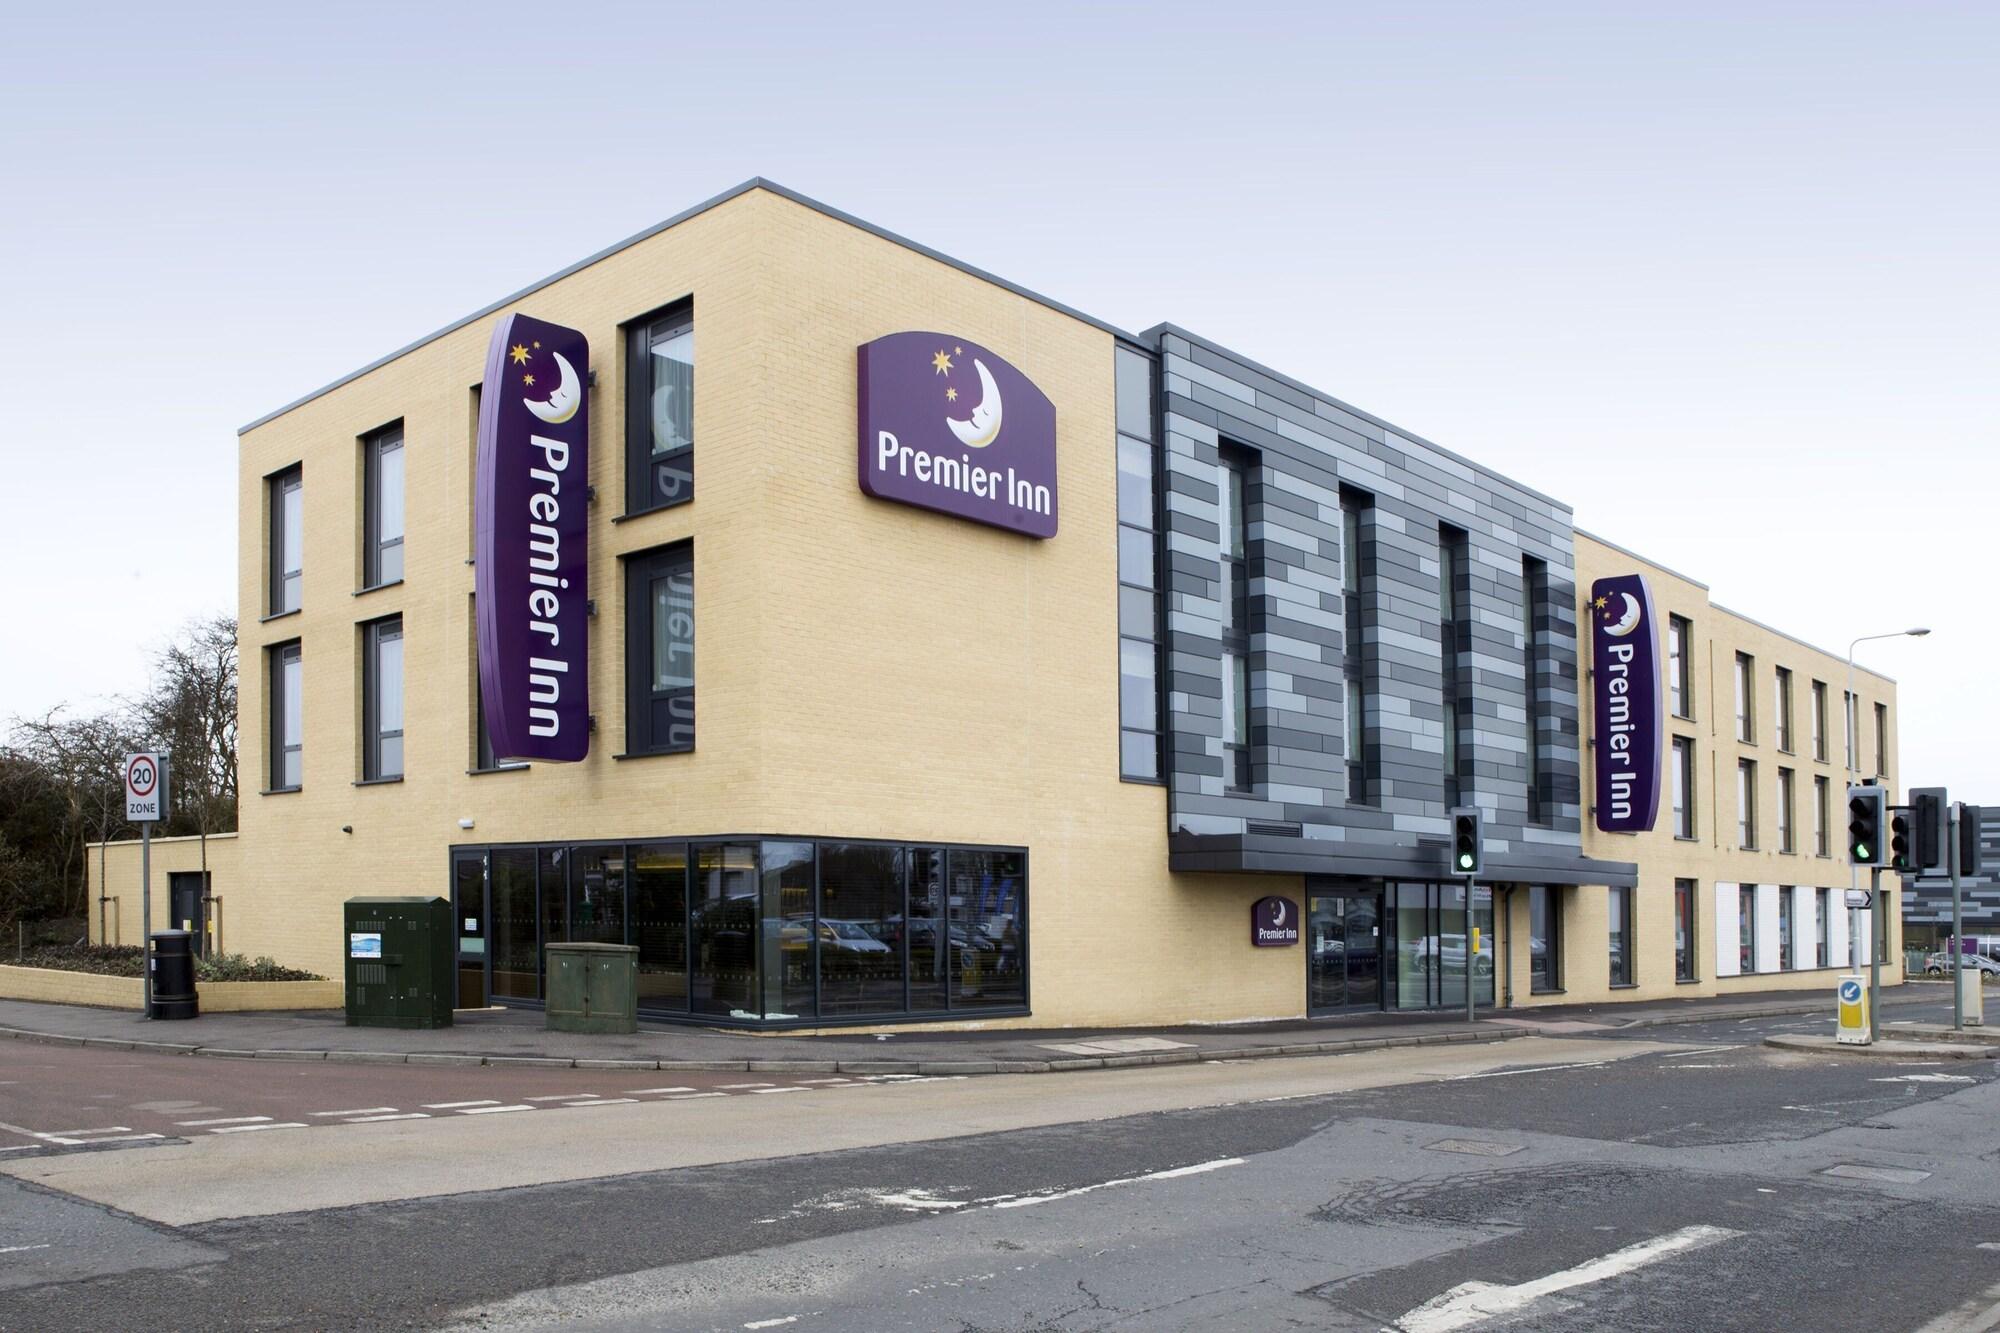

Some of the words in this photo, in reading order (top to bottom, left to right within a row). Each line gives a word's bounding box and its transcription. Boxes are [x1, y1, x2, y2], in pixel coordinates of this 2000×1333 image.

[879, 430, 1003, 500] Premier
[1008, 467, 1050, 516] Inn
[530, 434, 569, 646] Premier
[530, 656, 569, 737] Inn
[1608, 643, 1636, 765] Premier
[130, 803, 156, 814] ZONE
[133, 768, 152, 785] 20
[1611, 772, 1636, 819] Inn
[1259, 927, 1286, 940] Premier
[1286, 927, 1297, 939] Inn
